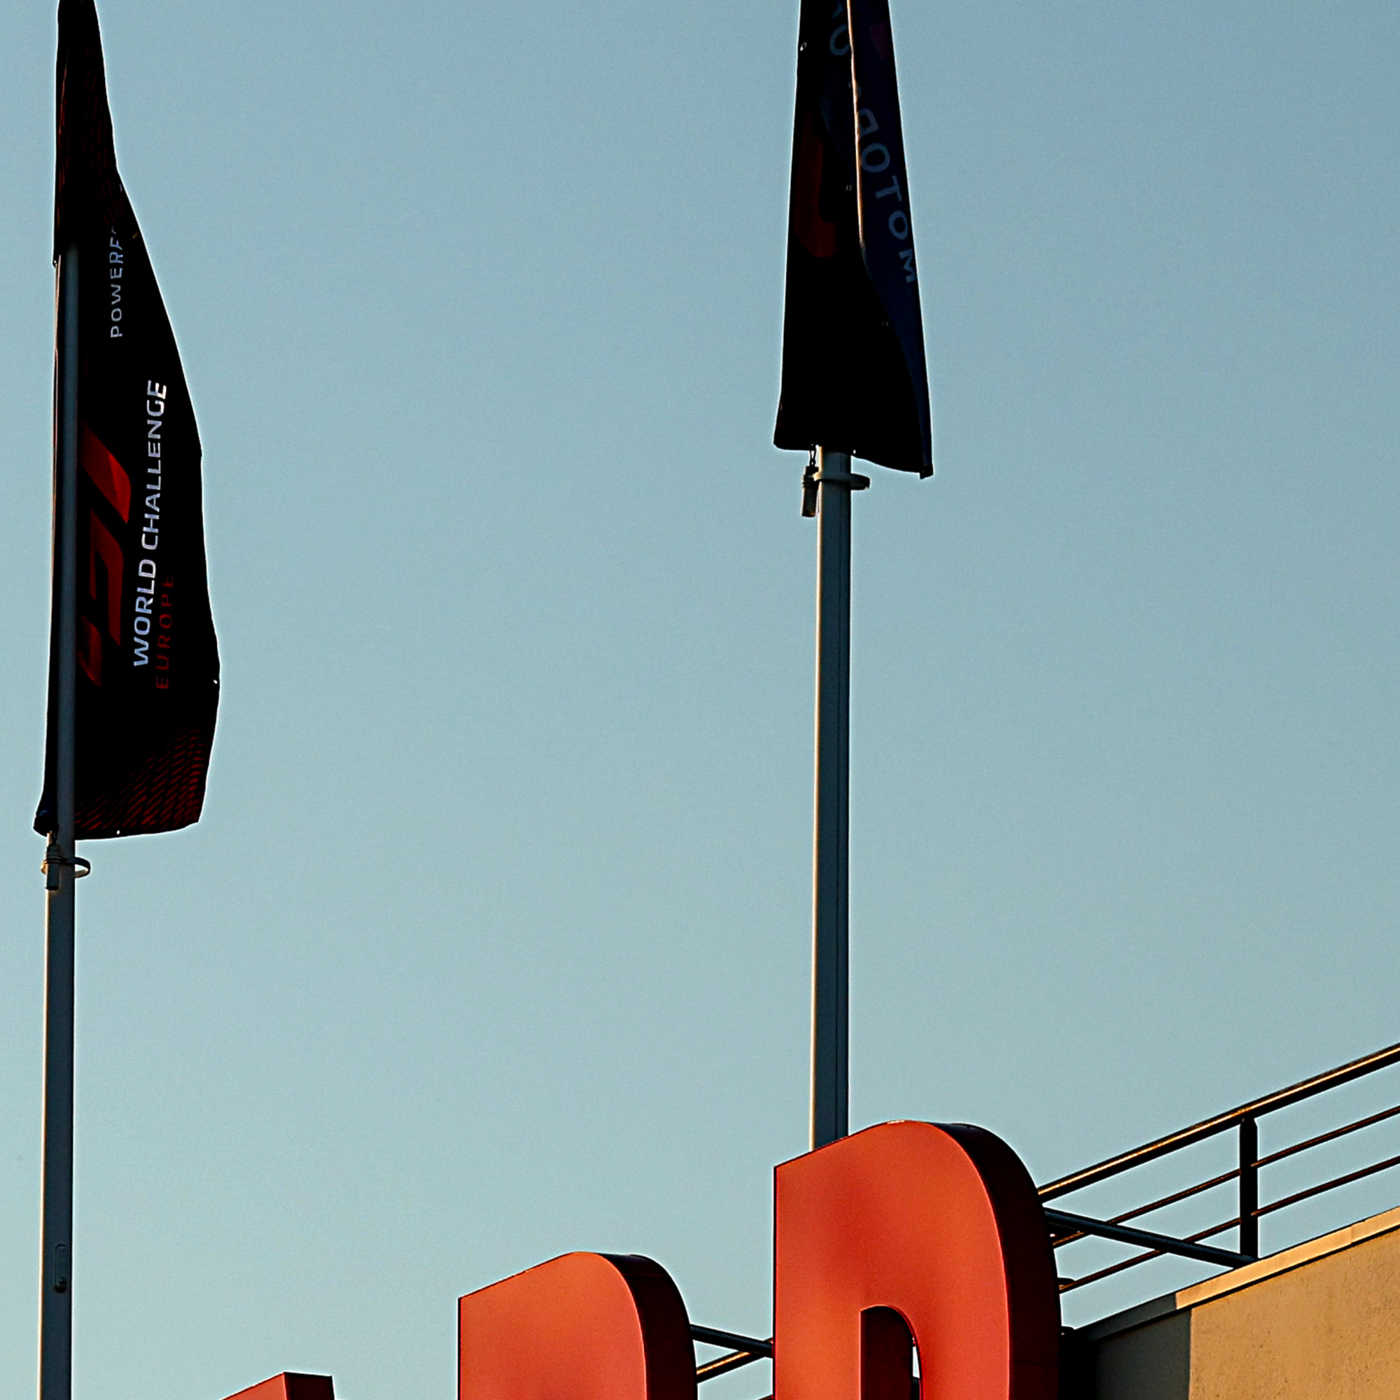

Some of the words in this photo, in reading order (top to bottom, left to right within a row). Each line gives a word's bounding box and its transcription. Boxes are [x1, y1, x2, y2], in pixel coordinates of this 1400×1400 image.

[141, 379, 167, 551] CHALLENGE
[133, 559, 157, 667] WORLD
[155, 575, 174, 690] EUROPE
